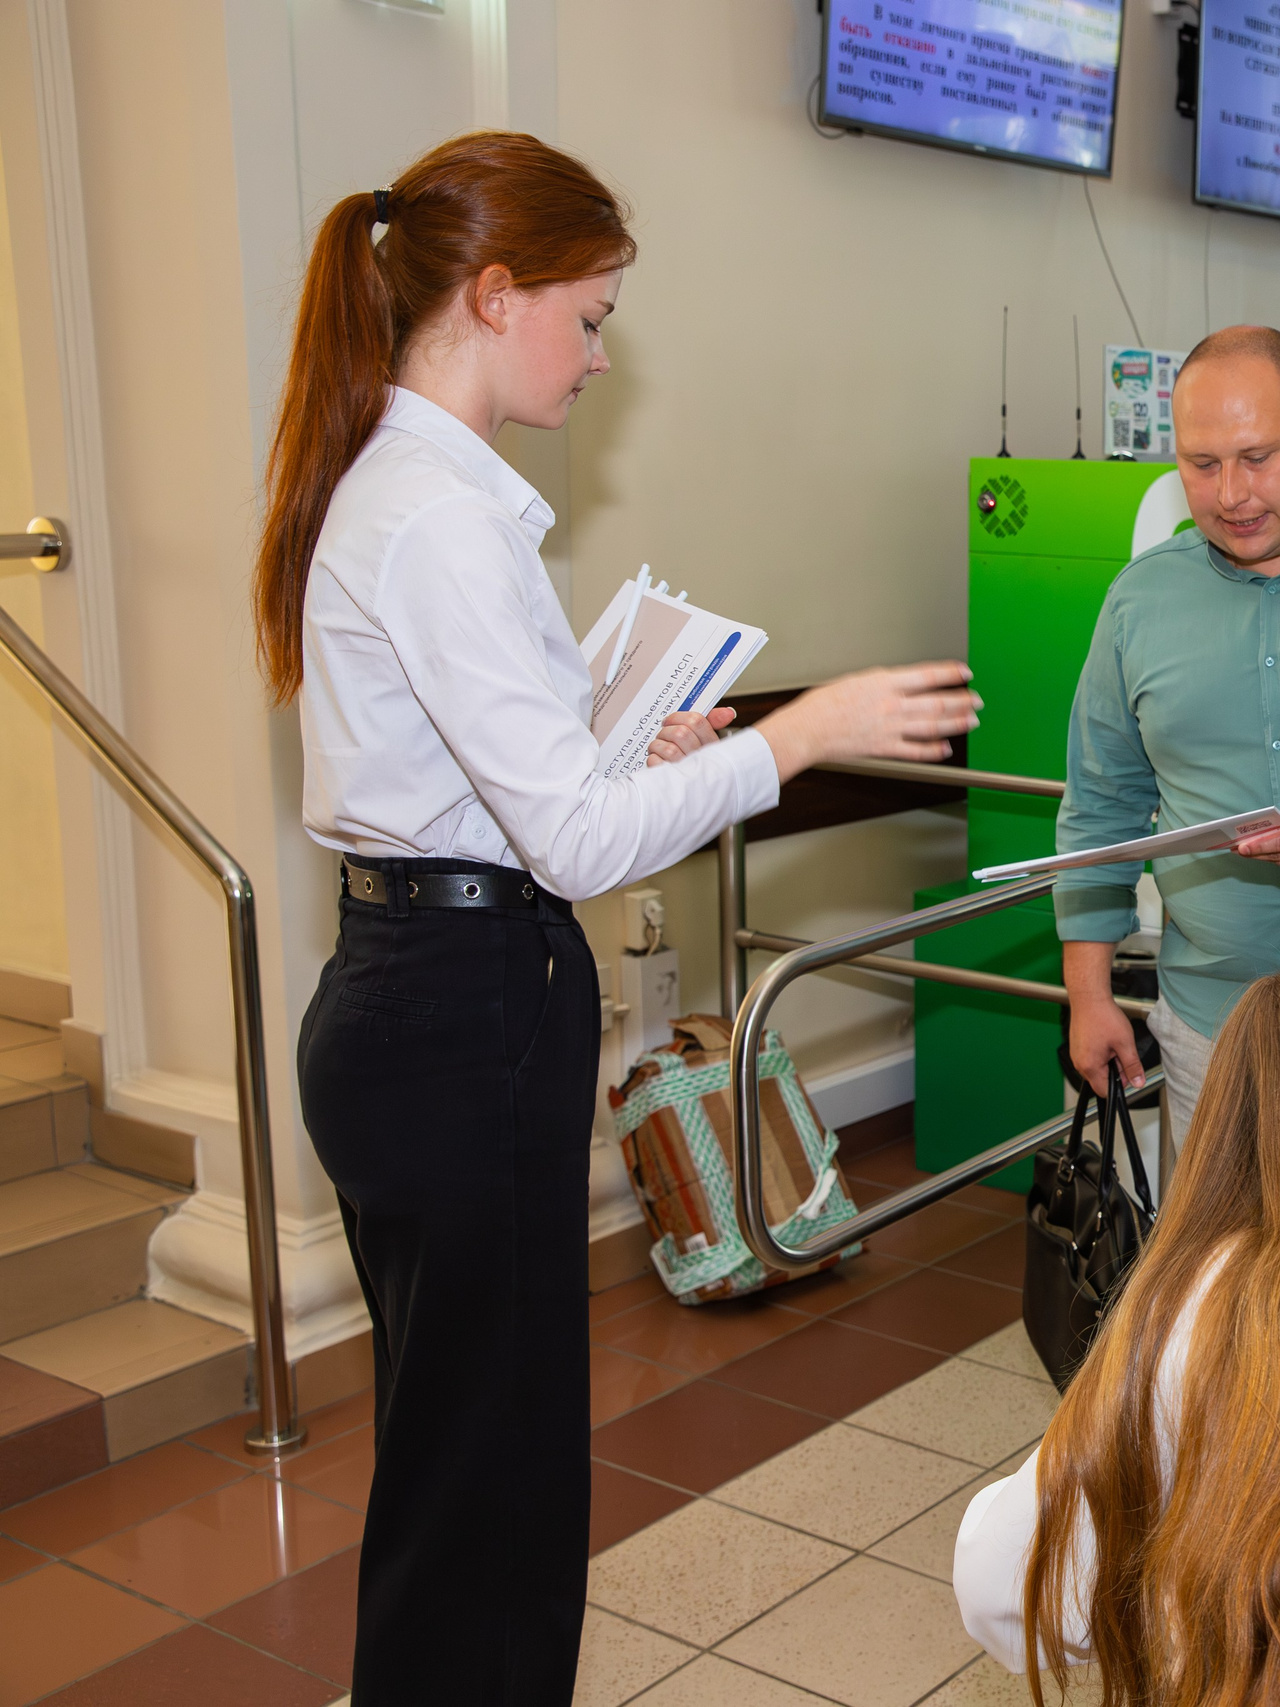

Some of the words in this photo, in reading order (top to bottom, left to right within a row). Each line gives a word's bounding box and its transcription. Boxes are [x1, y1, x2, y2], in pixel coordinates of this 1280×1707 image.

[840, 17, 871, 38] быть
[884, 33, 935, 53] отказано
[839, 62, 852, 75] по
[619, 727, 656, 774] граждан
[654, 718, 662, 726] к
[660, 666, 699, 717] закупкам
[632, 681, 674, 737] субъектов
[670, 653, 694, 680] МСП
